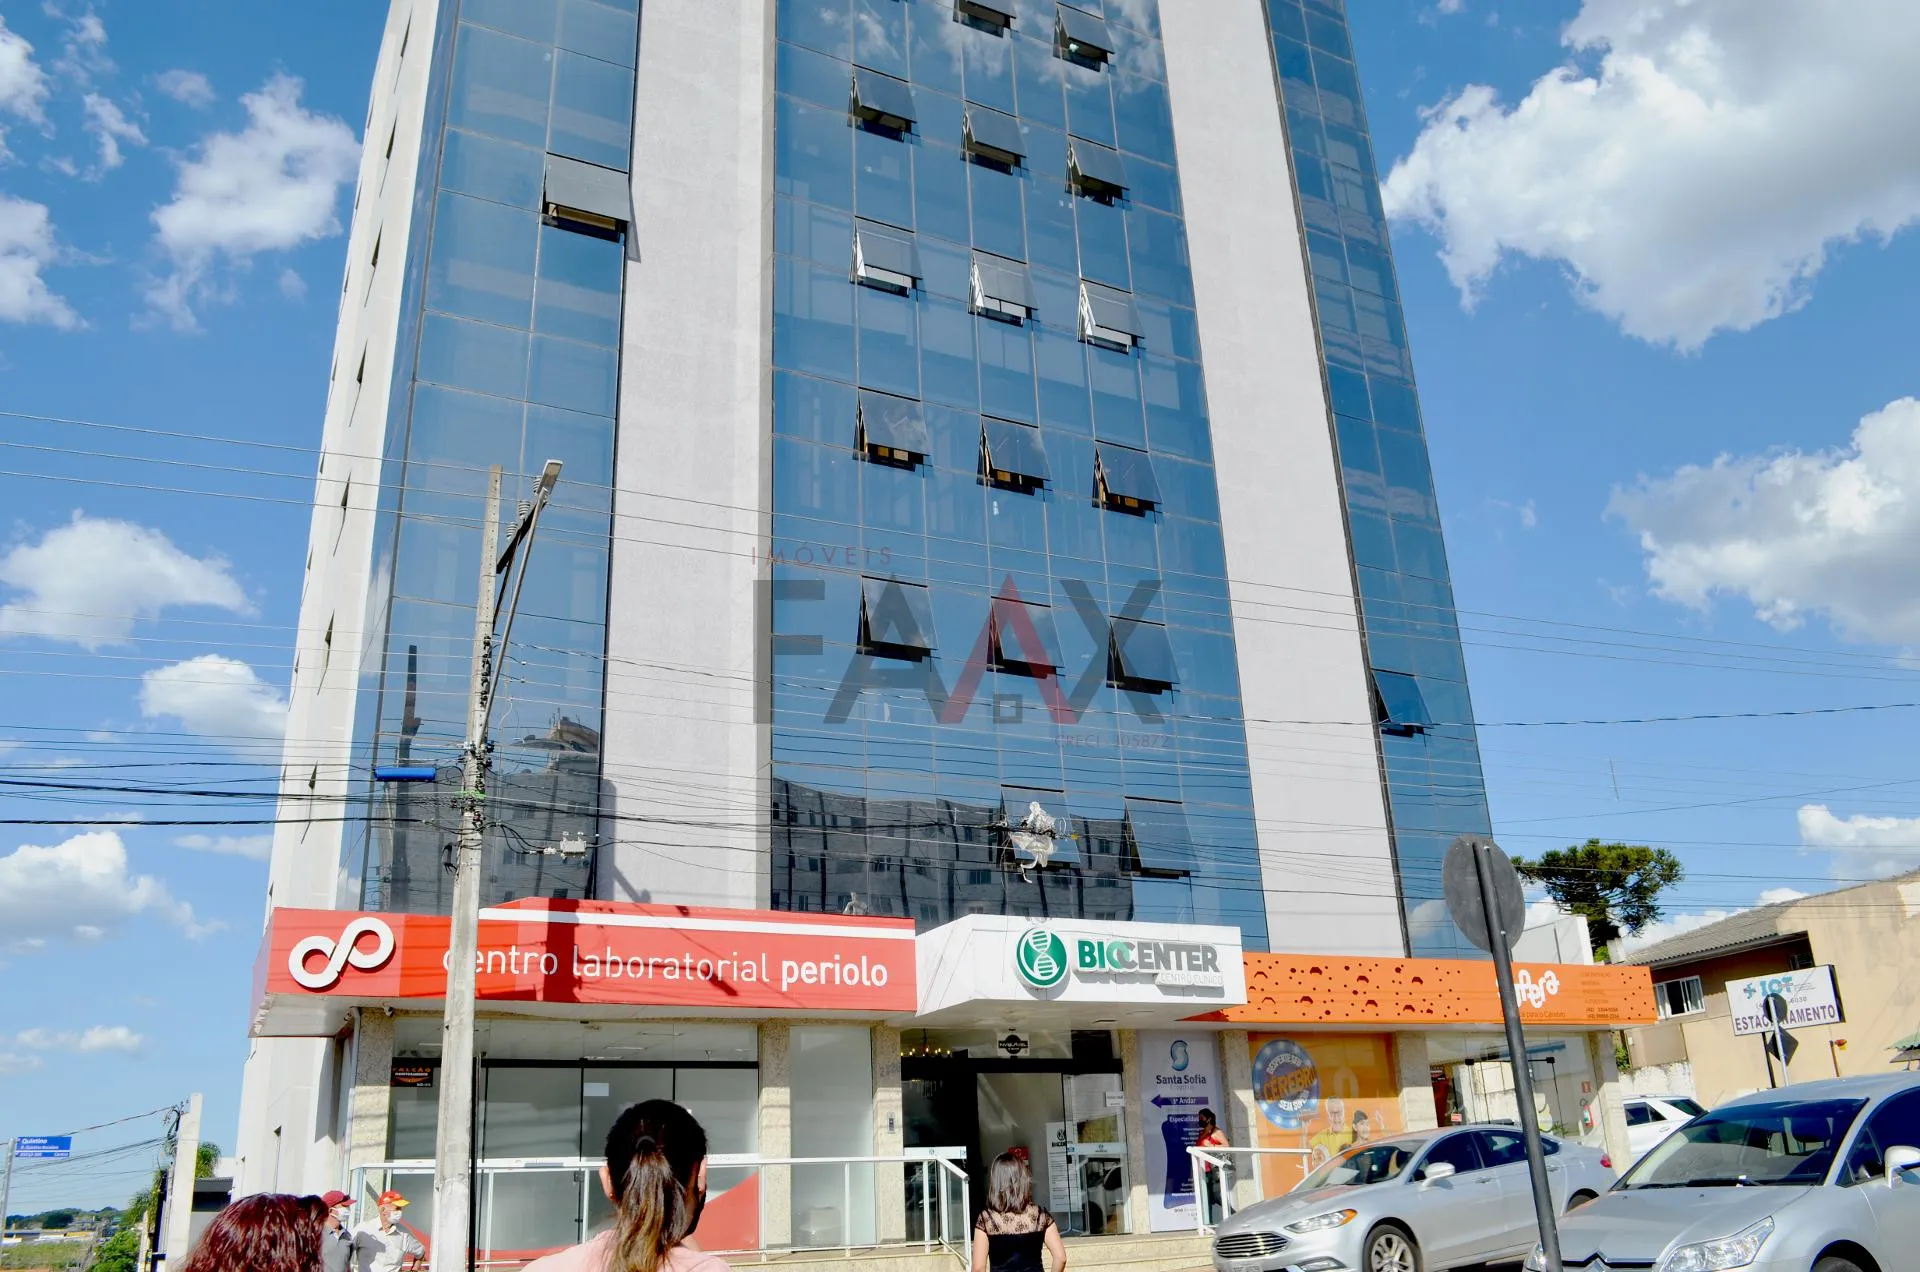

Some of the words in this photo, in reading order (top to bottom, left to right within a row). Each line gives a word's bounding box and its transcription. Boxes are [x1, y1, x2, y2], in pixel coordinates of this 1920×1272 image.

[572, 945, 770, 982] laboratorial
[781, 954, 888, 992] periolo
[1078, 940, 1221, 973] BIOCENTER
[1759, 976, 1794, 997] IOT
[1735, 1004, 1836, 1031] ESTACNAMENTO
[1156, 1074, 1182, 1085] Santa
[1183, 1074, 1207, 1085] Sofia
